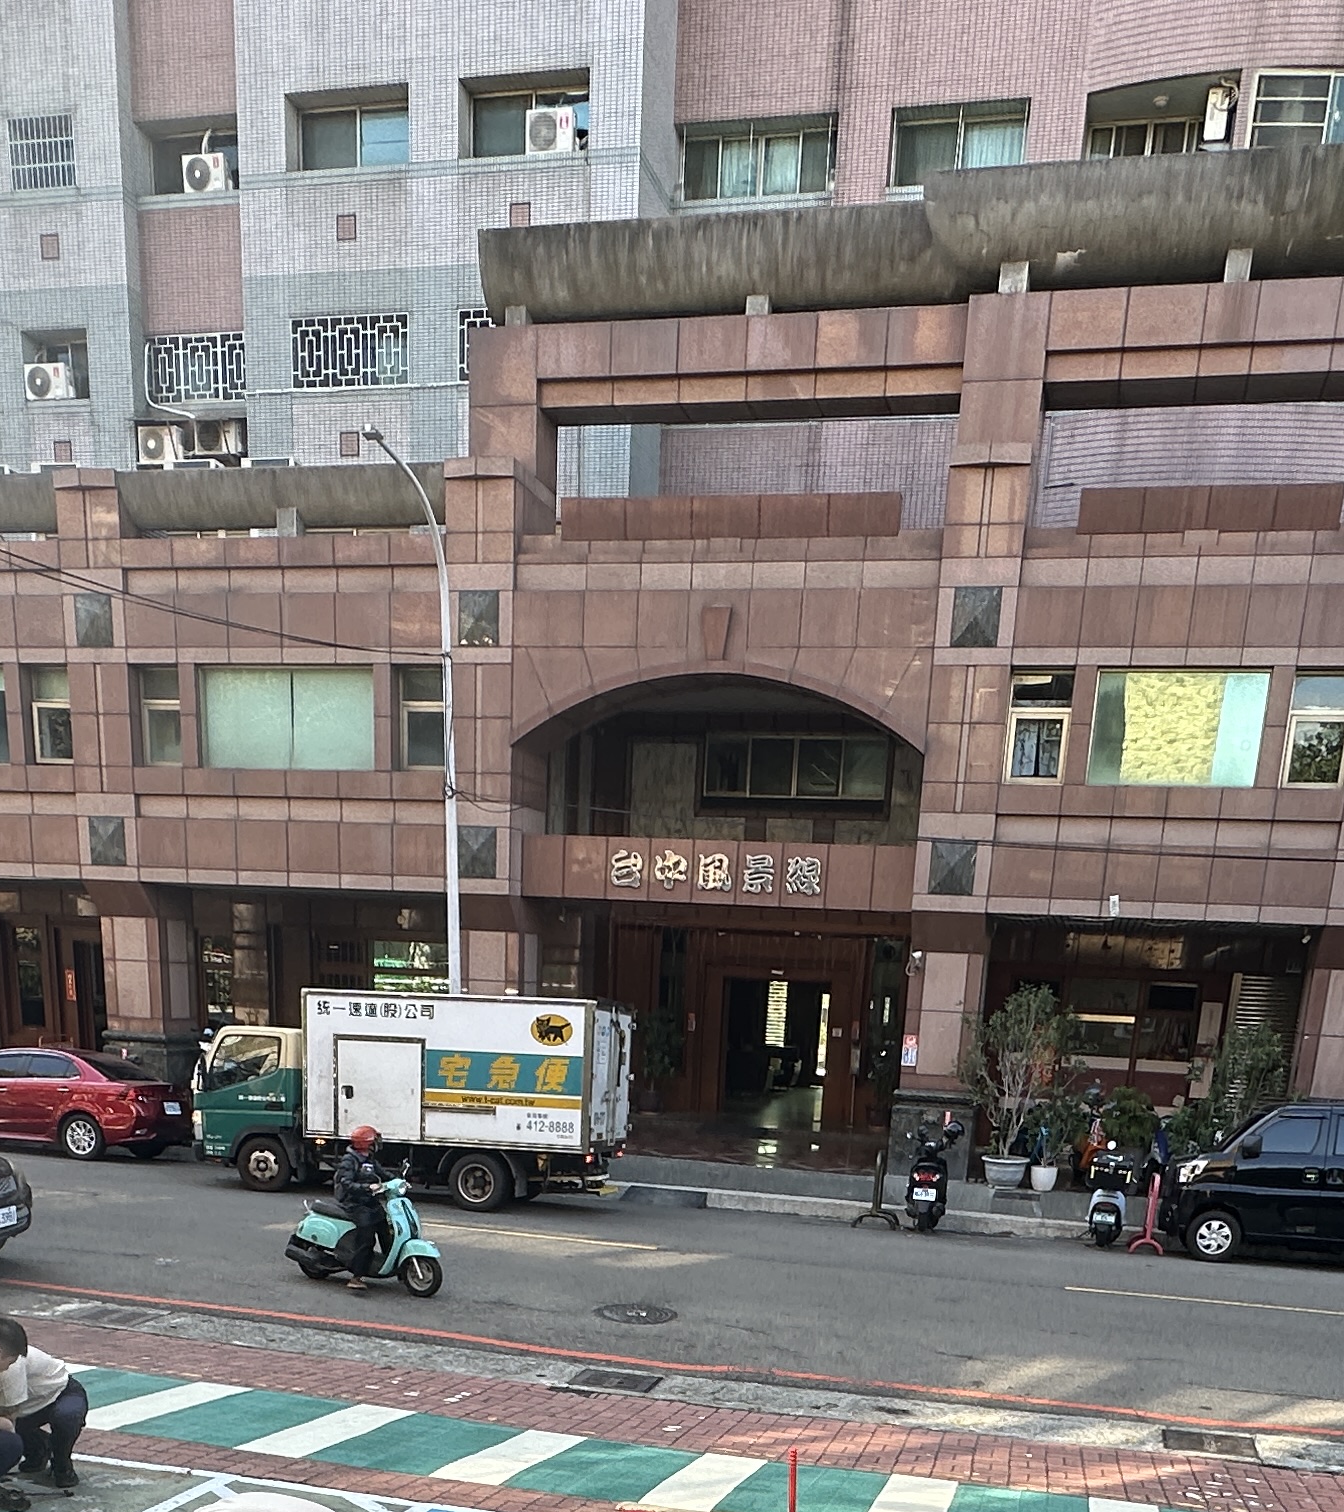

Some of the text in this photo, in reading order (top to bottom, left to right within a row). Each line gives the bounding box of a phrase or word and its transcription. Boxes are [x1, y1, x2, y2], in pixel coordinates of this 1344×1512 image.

[438, 1053, 570, 1093] 宅急便
[526, 1120, 575, 1134] 412-8888
